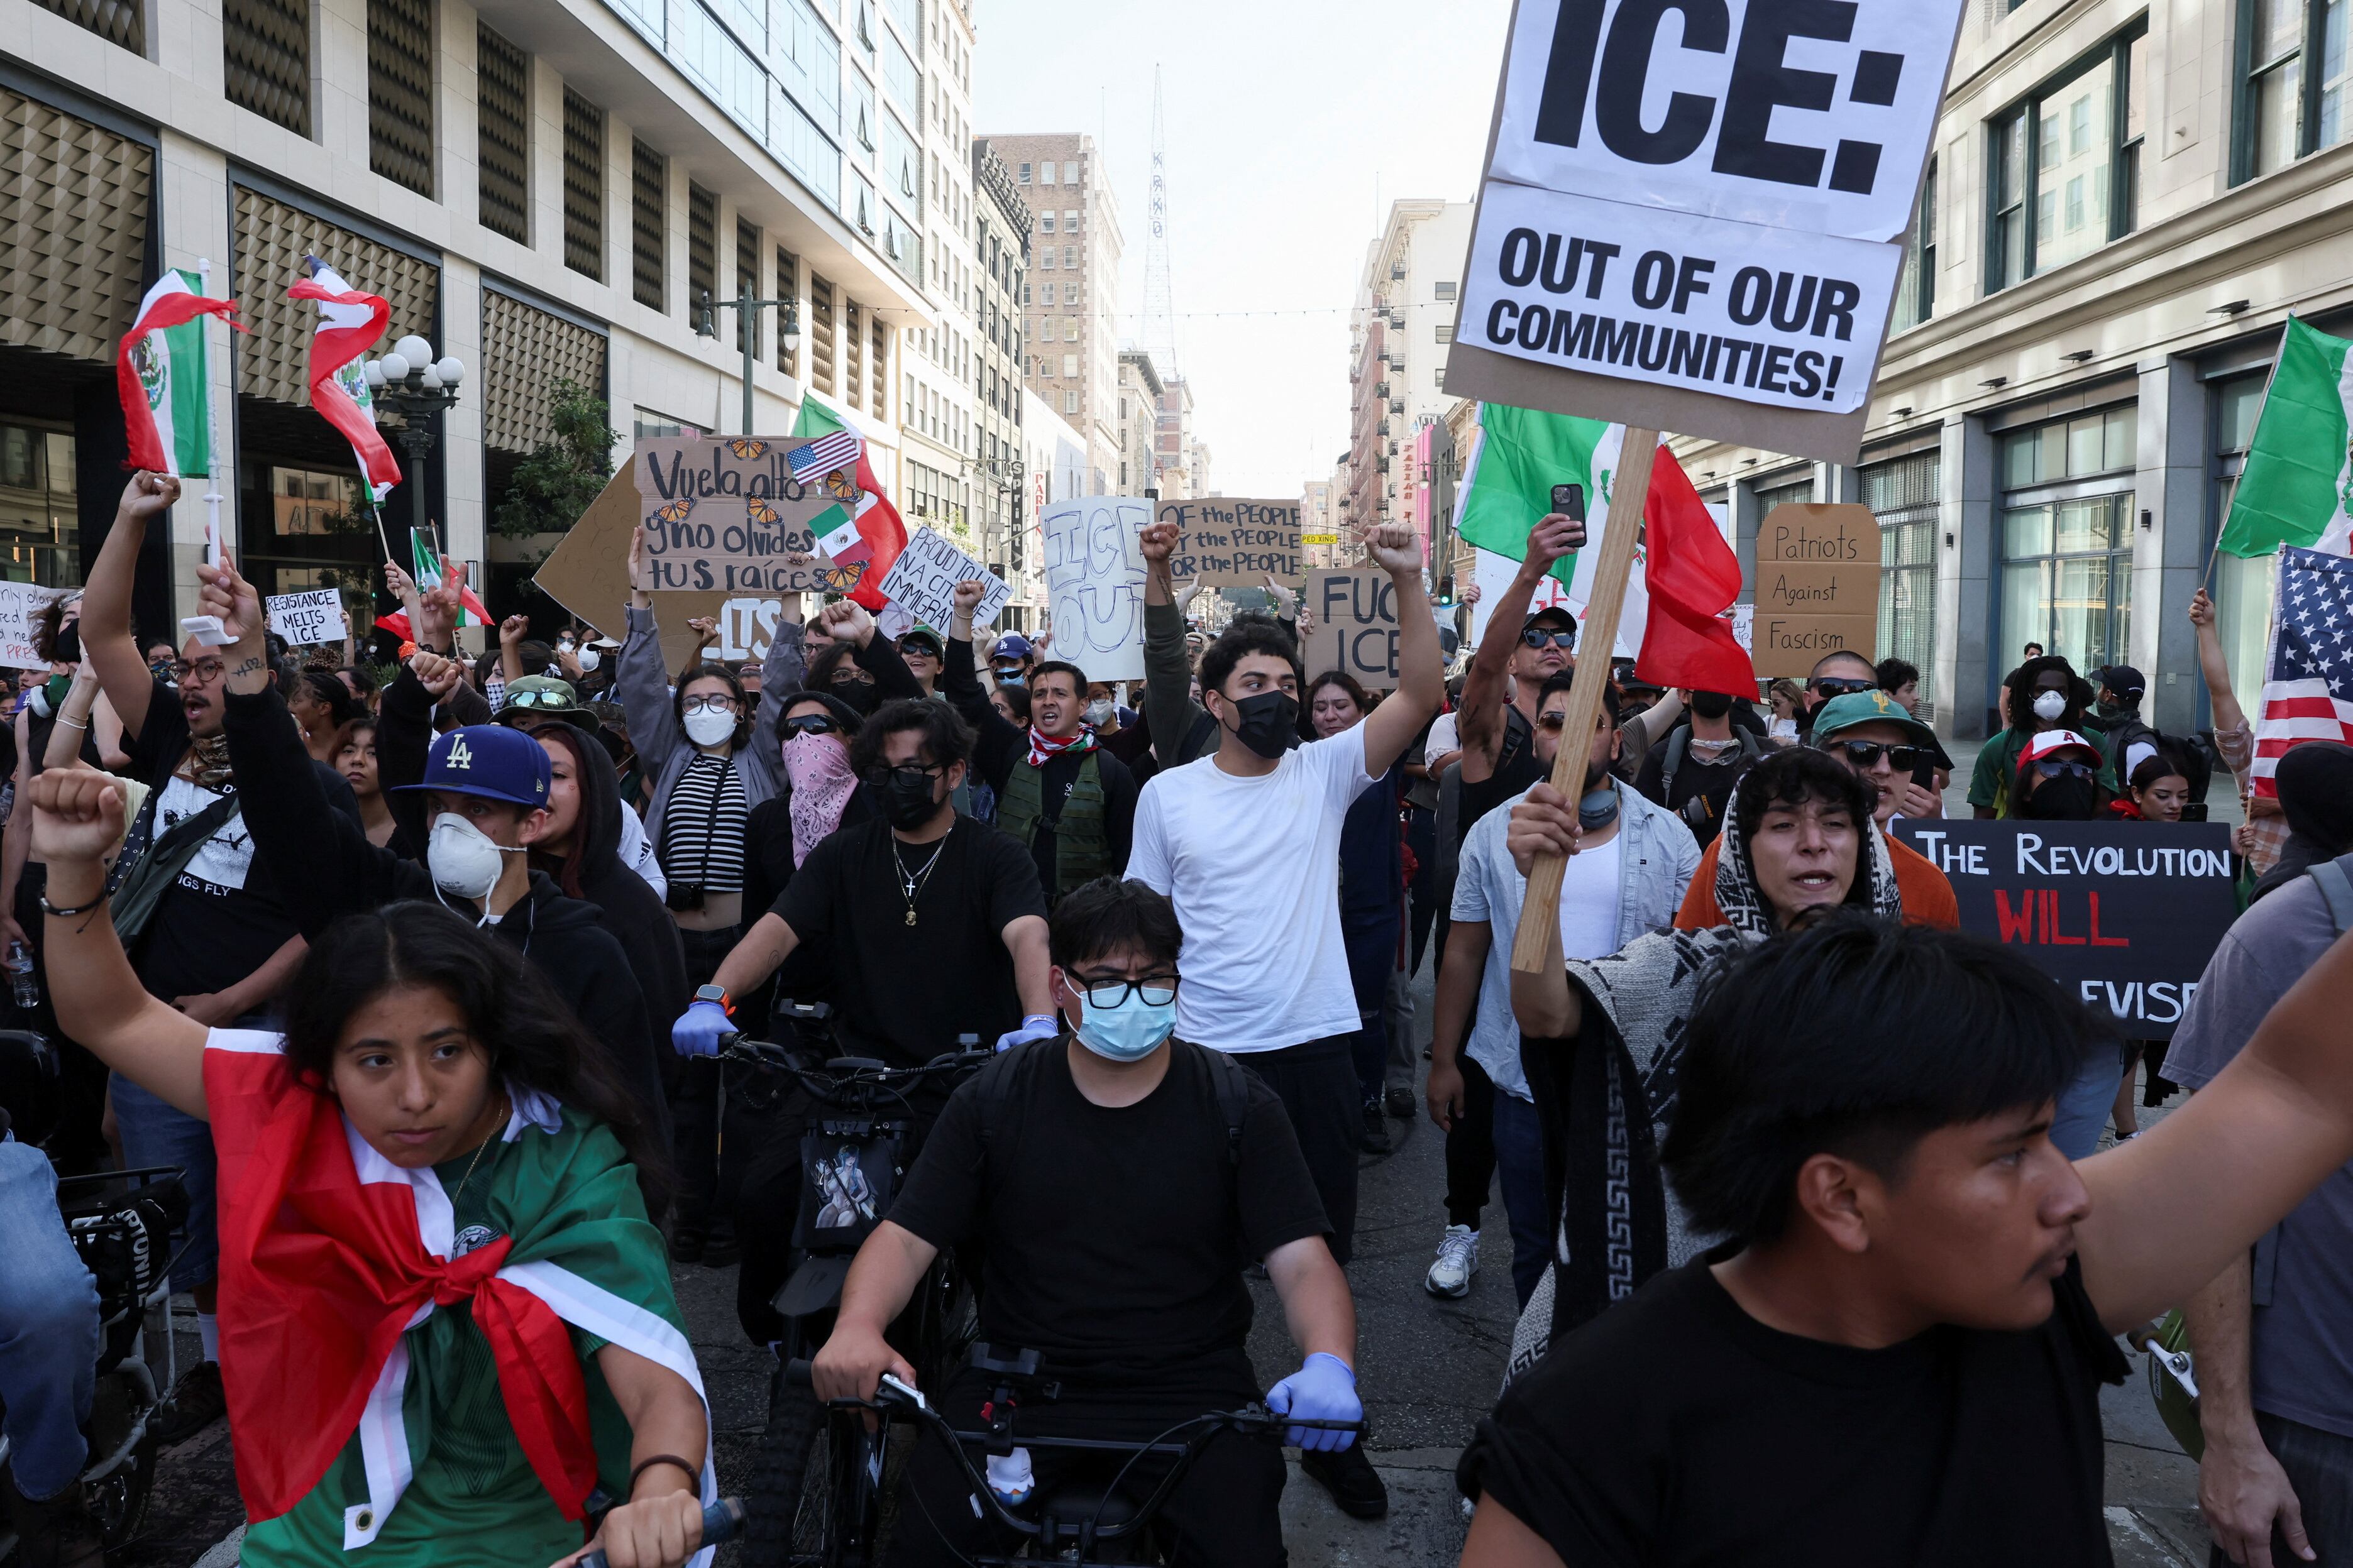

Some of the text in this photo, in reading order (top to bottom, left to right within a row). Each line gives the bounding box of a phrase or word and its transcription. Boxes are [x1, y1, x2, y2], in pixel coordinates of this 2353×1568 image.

[1534, 0, 1904, 195] ICE:
[1498, 228, 1861, 342] OUT OF OUR
[1486, 299, 1843, 401] COMMUNITIES!
[648, 447, 806, 502] Vuela alto
[1012, 463, 1022, 547] Sprint
[1201, 507, 1234, 524] the
[1235, 503, 1301, 527] PEOPLE
[723, 517, 815, 557] olvides
[910, 527, 959, 572] PROUD
[955, 557, 975, 582] TO
[1195, 531, 1227, 547] the
[1231, 529, 1300, 549] PEOPLE
[1775, 525, 1857, 560] Patriots
[647, 559, 830, 593] tus raíces
[895, 551, 916, 573] IN
[909, 564, 926, 584] A
[929, 574, 956, 606] CIT
[1200, 554, 1232, 573] the
[1232, 552, 1301, 576] PEOPLE
[267, 590, 336, 612] RESISTANCE
[883, 571, 954, 635] IMMIGRAN
[1323, 576, 1400, 625] FUC
[1772, 574, 1837, 606] Against
[282, 610, 325, 629] MELTS
[1770, 622, 1843, 649] Fascism
[1338, 628, 1400, 678] ICE
[446, 733, 472, 770] LA
[1915, 830, 2231, 877] THE REVOLUTION
[177, 874, 231, 897] IGS FLY
[1993, 889, 2129, 947] WILL
